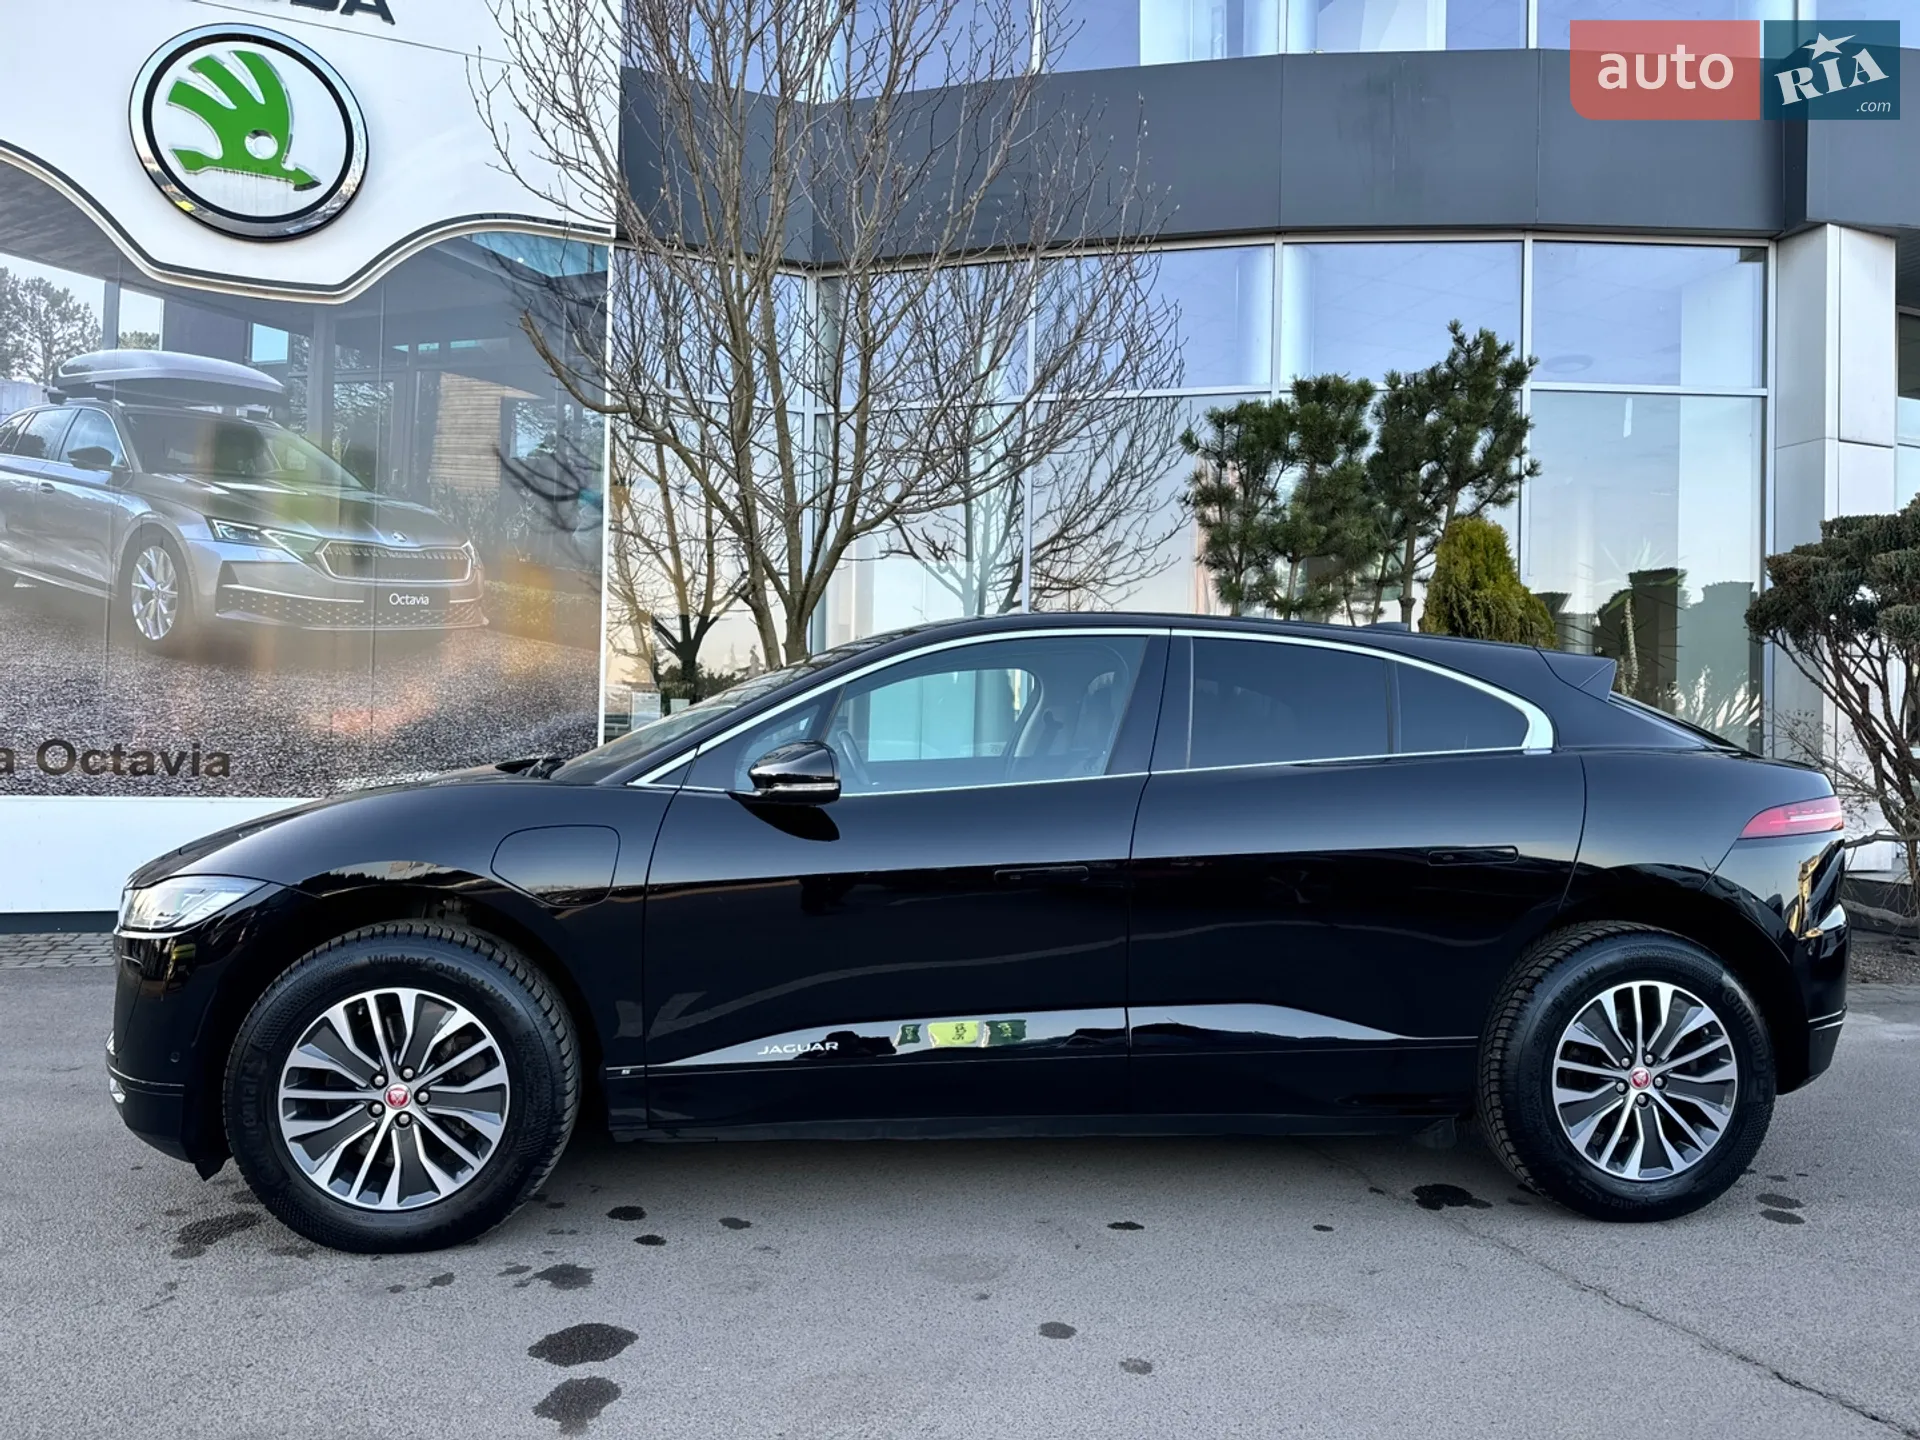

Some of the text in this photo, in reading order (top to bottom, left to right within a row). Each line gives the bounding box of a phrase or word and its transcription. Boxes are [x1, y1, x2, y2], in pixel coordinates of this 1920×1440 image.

[389, 592, 430, 606] Octavia
[36, 739, 231, 777] Octavia
[757, 1041, 839, 1055] JAGUAR
